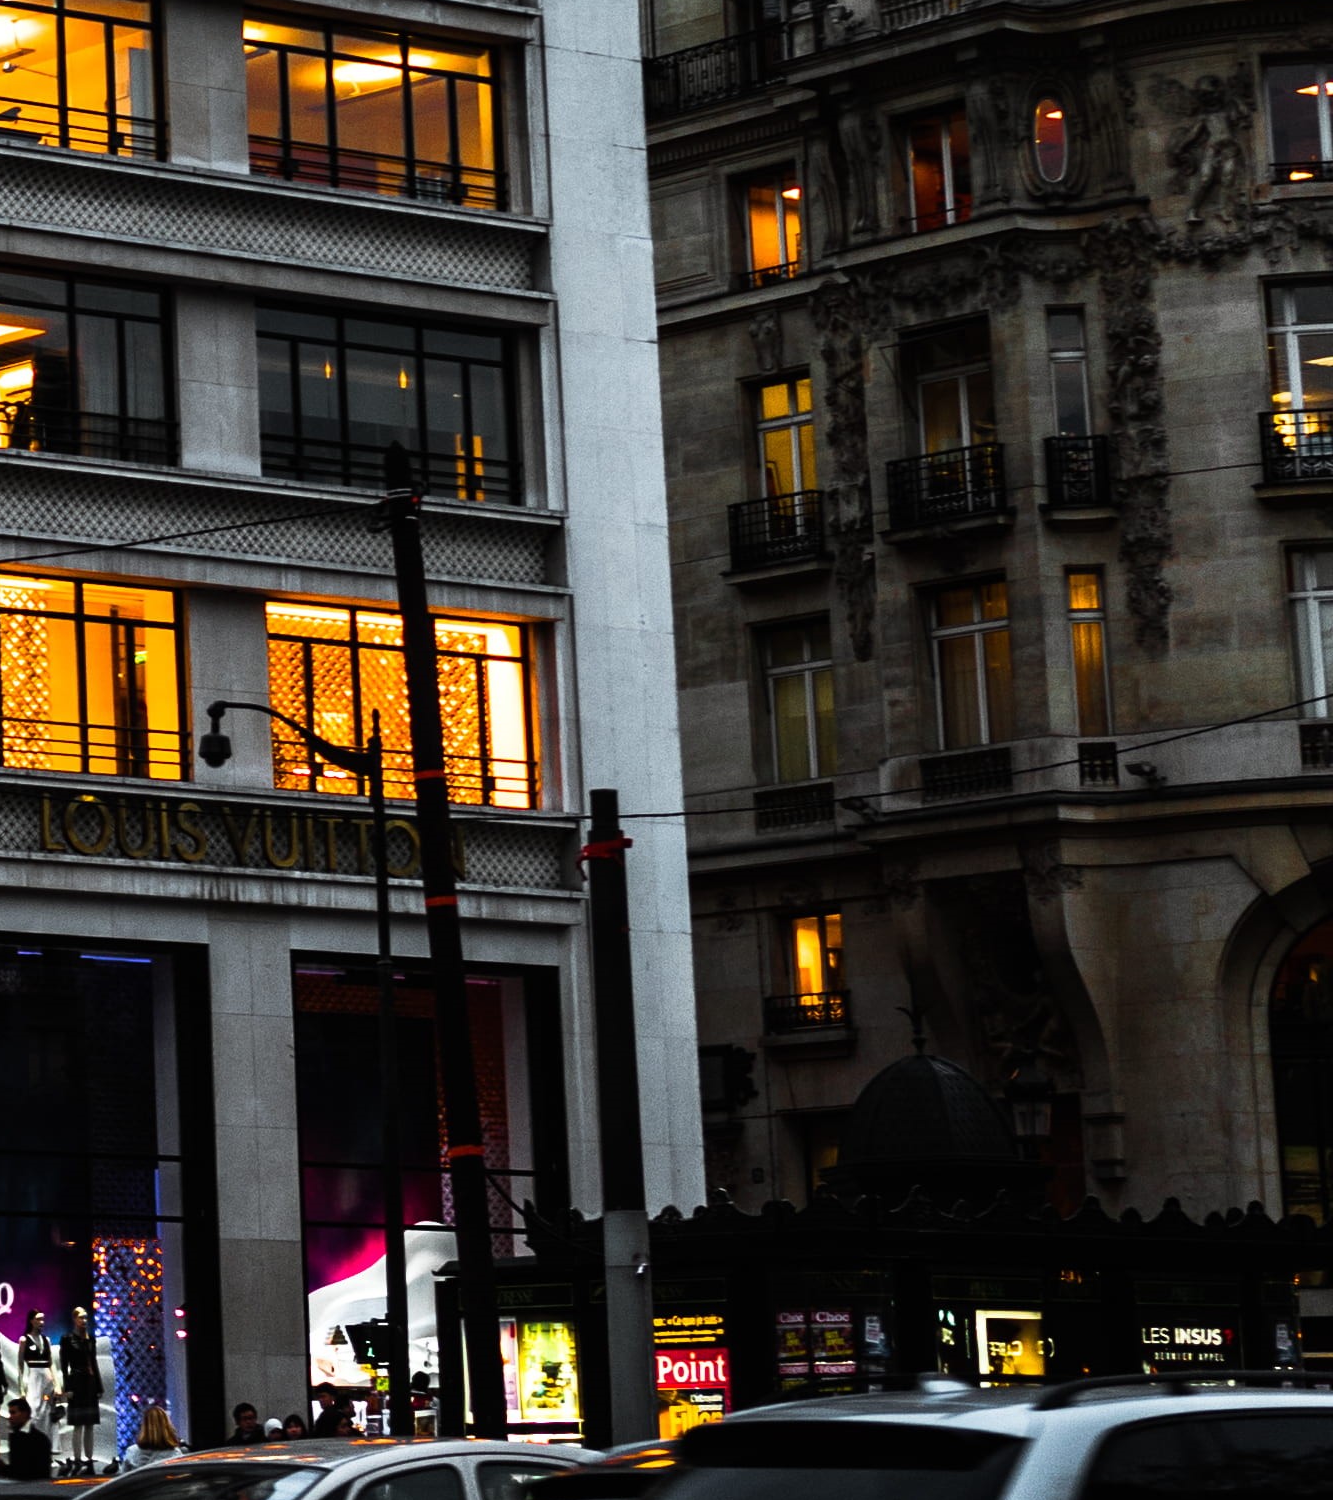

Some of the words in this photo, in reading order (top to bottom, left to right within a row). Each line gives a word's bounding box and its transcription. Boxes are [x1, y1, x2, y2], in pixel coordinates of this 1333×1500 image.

[41, 792, 208, 862] LOUIS
[815, 1311, 850, 1322] Choc
[1141, 1327, 1170, 1344] LES
[1154, 1352, 1193, 1361] DERNIER
[1198, 1353, 1225, 1362] APPEL
[655, 1351, 728, 1384] Point
